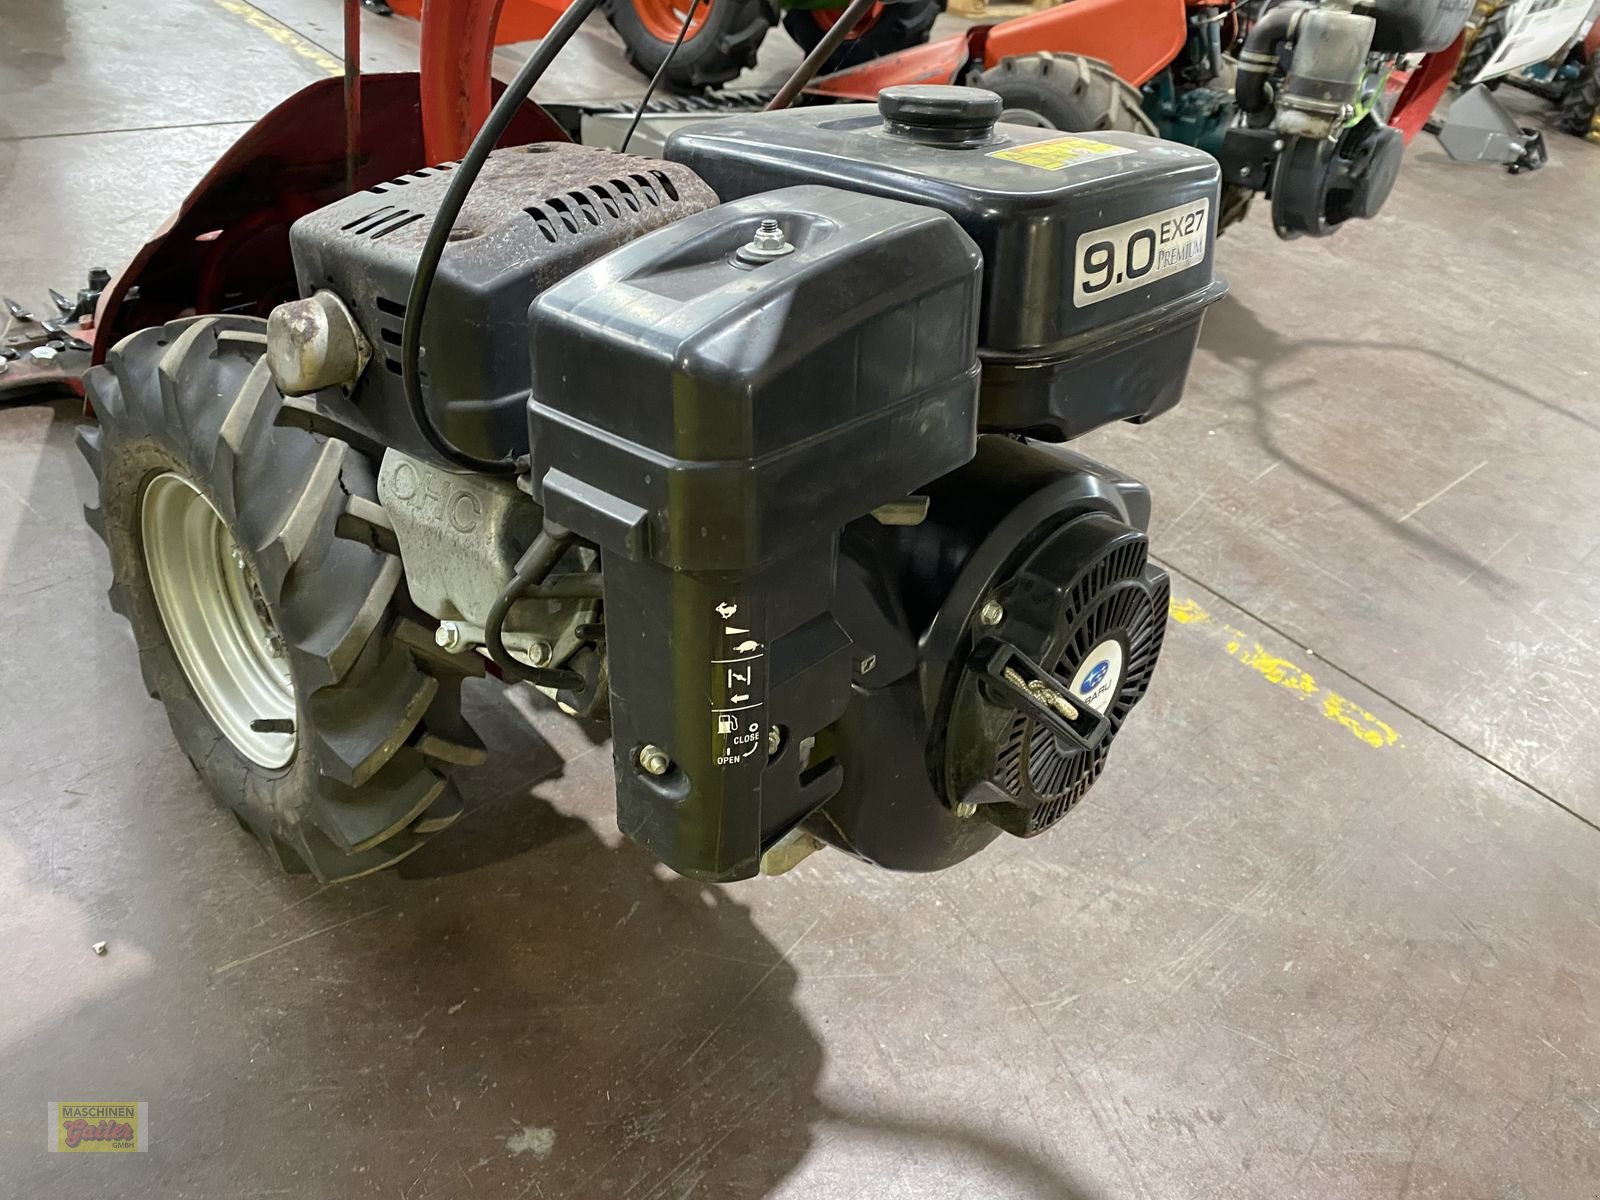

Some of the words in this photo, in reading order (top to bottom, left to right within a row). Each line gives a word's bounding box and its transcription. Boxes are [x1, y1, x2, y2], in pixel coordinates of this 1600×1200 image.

[1160, 208, 1205, 244] EX27
[1082, 228, 1156, 294] 9.0
[389, 459, 484, 534] OHC
[733, 731, 760, 745] CLOSE
[717, 755, 740, 765] OPEN
